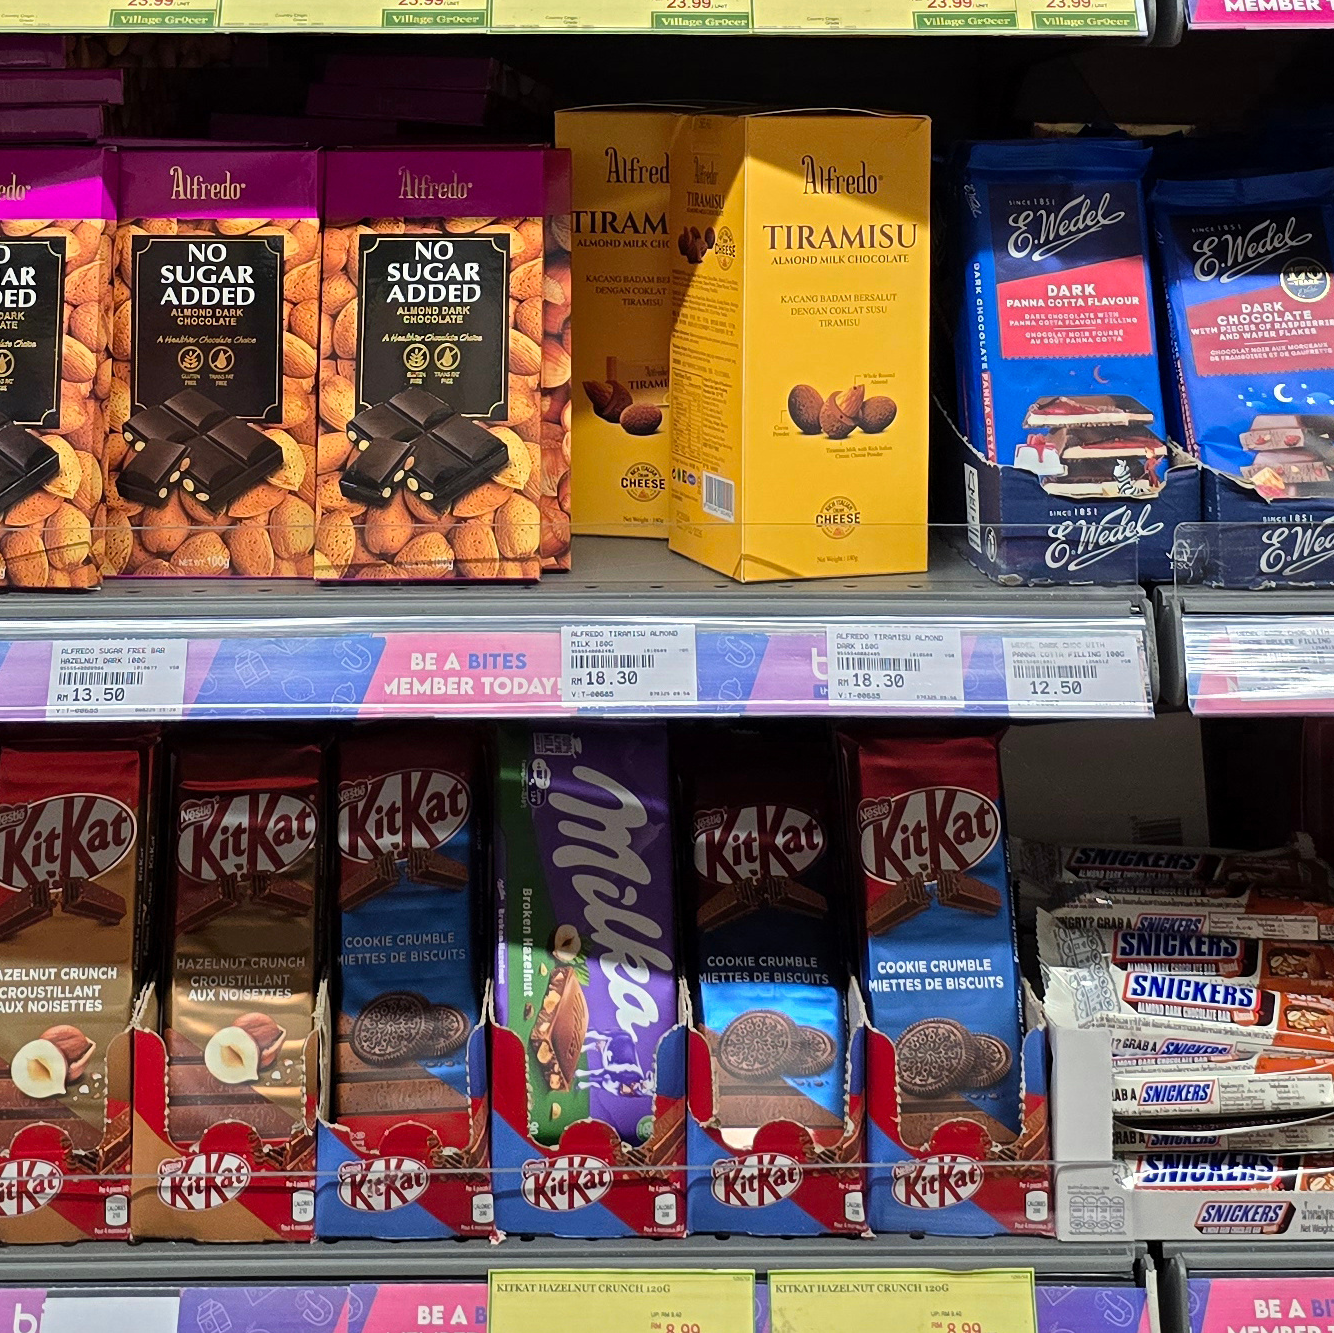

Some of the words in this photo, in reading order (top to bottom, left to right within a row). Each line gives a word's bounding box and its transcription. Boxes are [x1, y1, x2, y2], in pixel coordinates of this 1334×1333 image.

[170, 165, 242, 201] Alfredo
[803, 155, 879, 196] Alfredo
[1007, 192, 1126, 262] E.Wedel
[763, 223, 918, 251] TIRAMISU
[188, 243, 227, 263] NO
[160, 265, 254, 284] SUGAR
[160, 286, 255, 306] ADDED
[780, 293, 816, 303] KACANG
[819, 293, 848, 303] BADAM
[851, 292, 897, 302] BERSALUT
[1047, 284, 1096, 297] DARK
[1006, 298, 1045, 308] PANNA
[1048, 297, 1086, 308] COTTA
[1088, 296, 1140, 307] FLAVOUR
[410, 653, 437, 670] BE
[443, 653, 461, 670] A
[468, 653, 527, 669] BITES
[384, 678, 474, 695] MEMBER
[481, 678, 562, 695] TODAY!
[586, 671, 638, 685] 18.30
[1029, 681, 1082, 695] 12.50
[873, 790, 993, 878] KitKat
[553, 764, 674, 1042] Milka
[61, 967, 117, 980] CRUNCH
[877, 961, 927, 974] COOKIE
[930, 959, 992, 973] CRUMBLE
[869, 979, 922, 993] MIETTES
[925, 977, 944, 991] DE
[946, 976, 1004, 990] BISCUITS
[28, 999, 103, 1013] NOISETTES
[497, 1284, 537, 1293] KITKAT
[538, 1284, 596, 1293] HAZELNUT
[598, 1284, 644, 1293] CRUNCH
[647, 1285, 671, 1293] 120G
